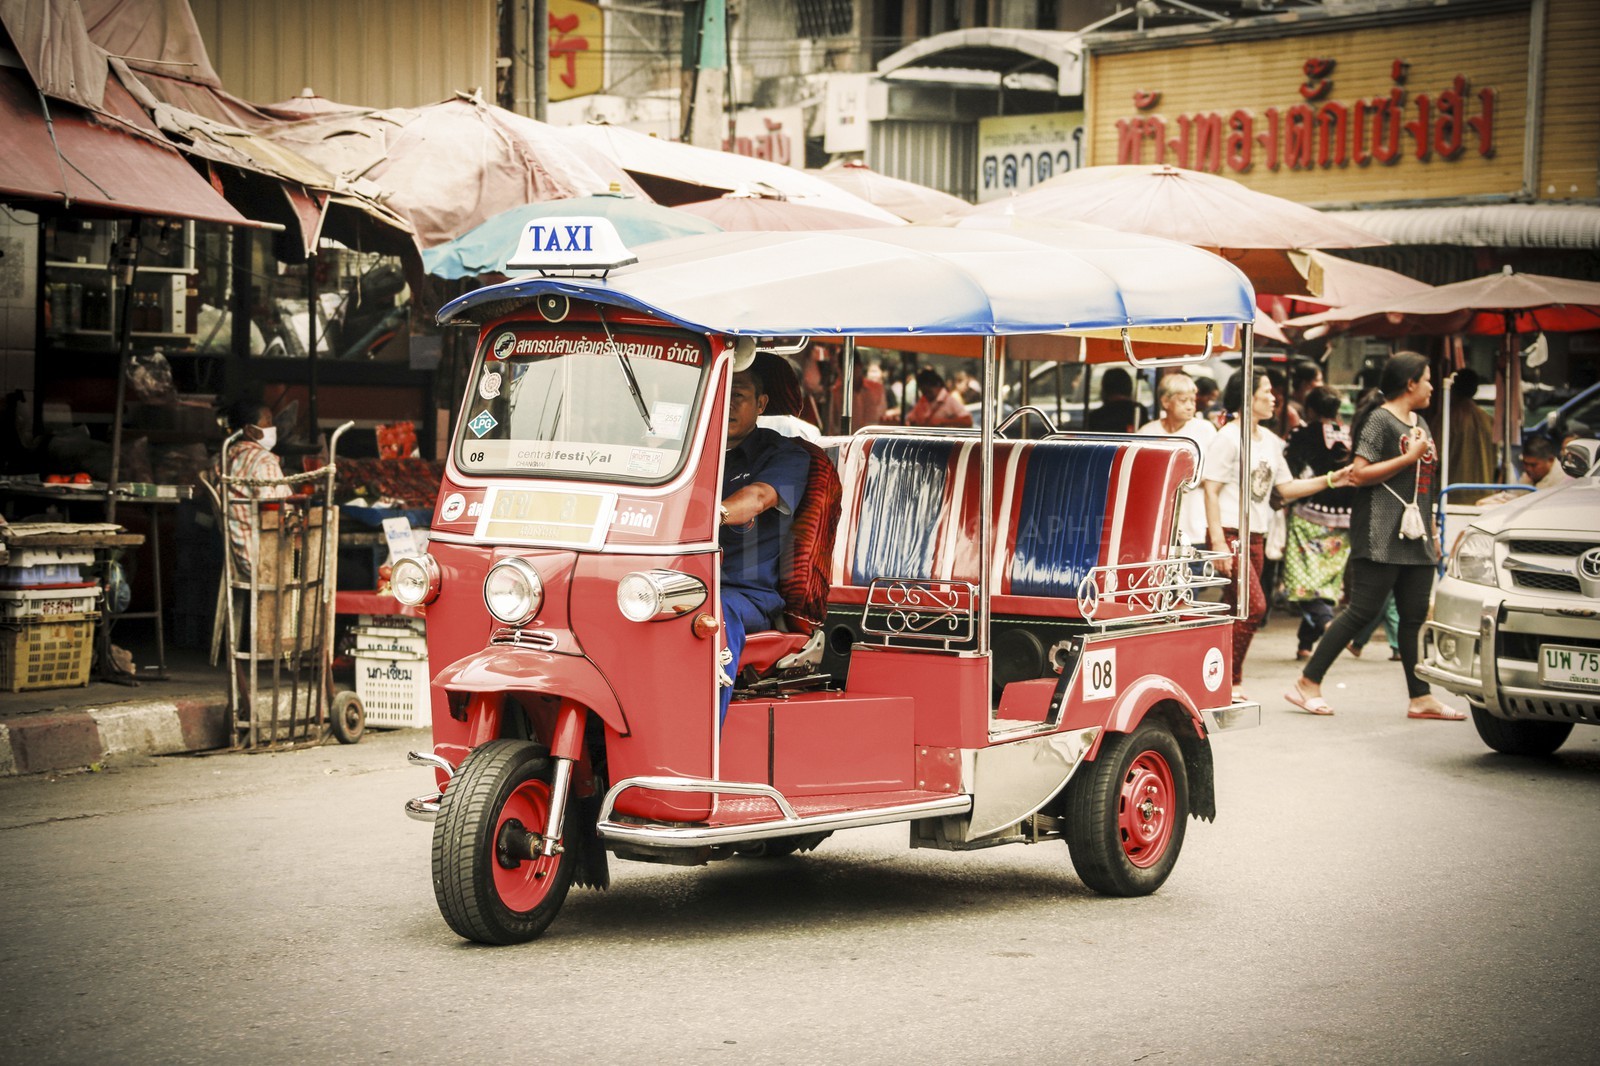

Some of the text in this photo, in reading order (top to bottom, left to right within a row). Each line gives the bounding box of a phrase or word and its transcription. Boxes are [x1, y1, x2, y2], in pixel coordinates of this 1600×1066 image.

[529, 226, 593, 251] TAXI
[667, 342, 700, 363] จำกัด
[473, 418, 492, 430] LPG
[470, 452, 484, 462] 08
[1546, 650, 1599, 672] บพ 75
[1092, 660, 1113, 690] 08
